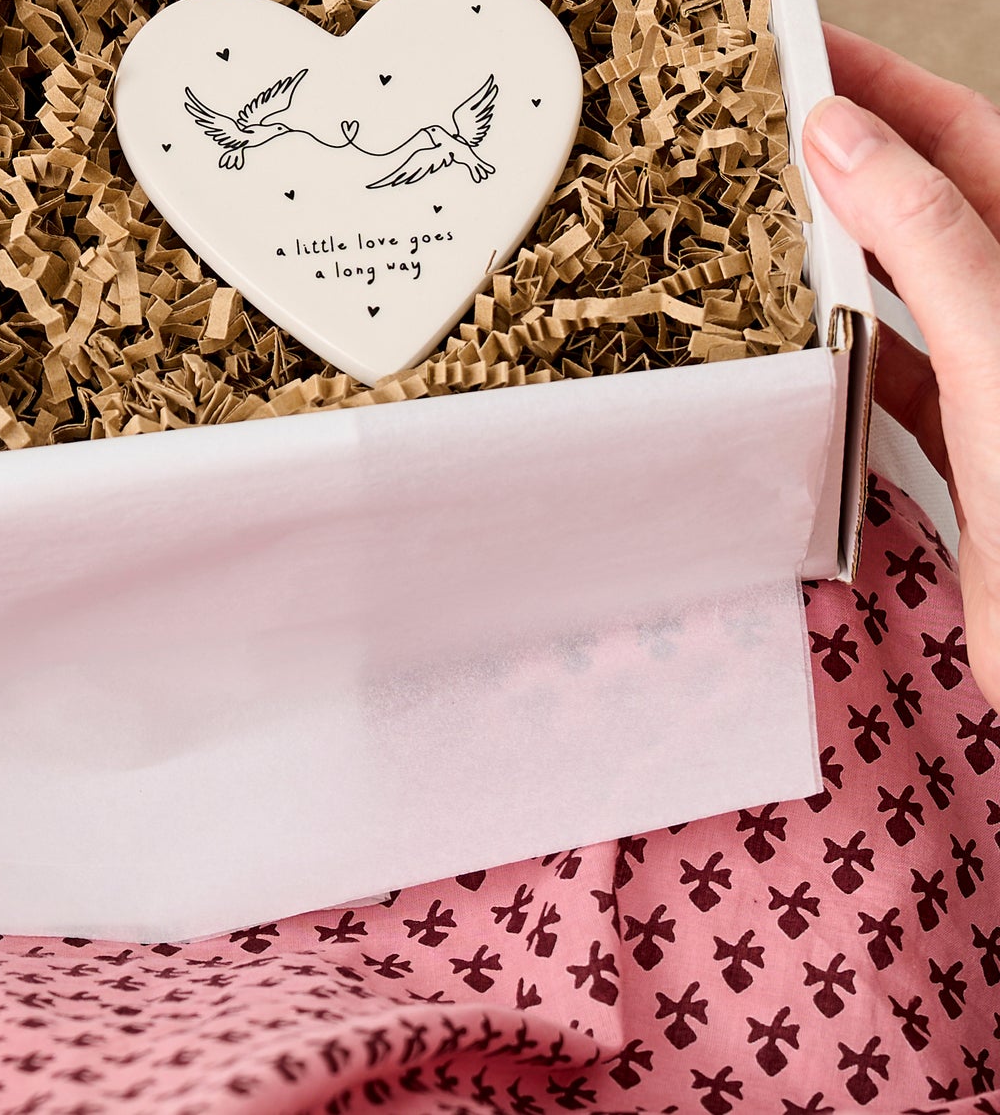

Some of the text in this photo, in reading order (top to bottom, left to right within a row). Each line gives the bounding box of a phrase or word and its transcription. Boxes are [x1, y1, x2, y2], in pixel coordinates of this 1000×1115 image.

[276, 231, 454, 257] a little love goes
[315, 261, 421, 285] a long way
